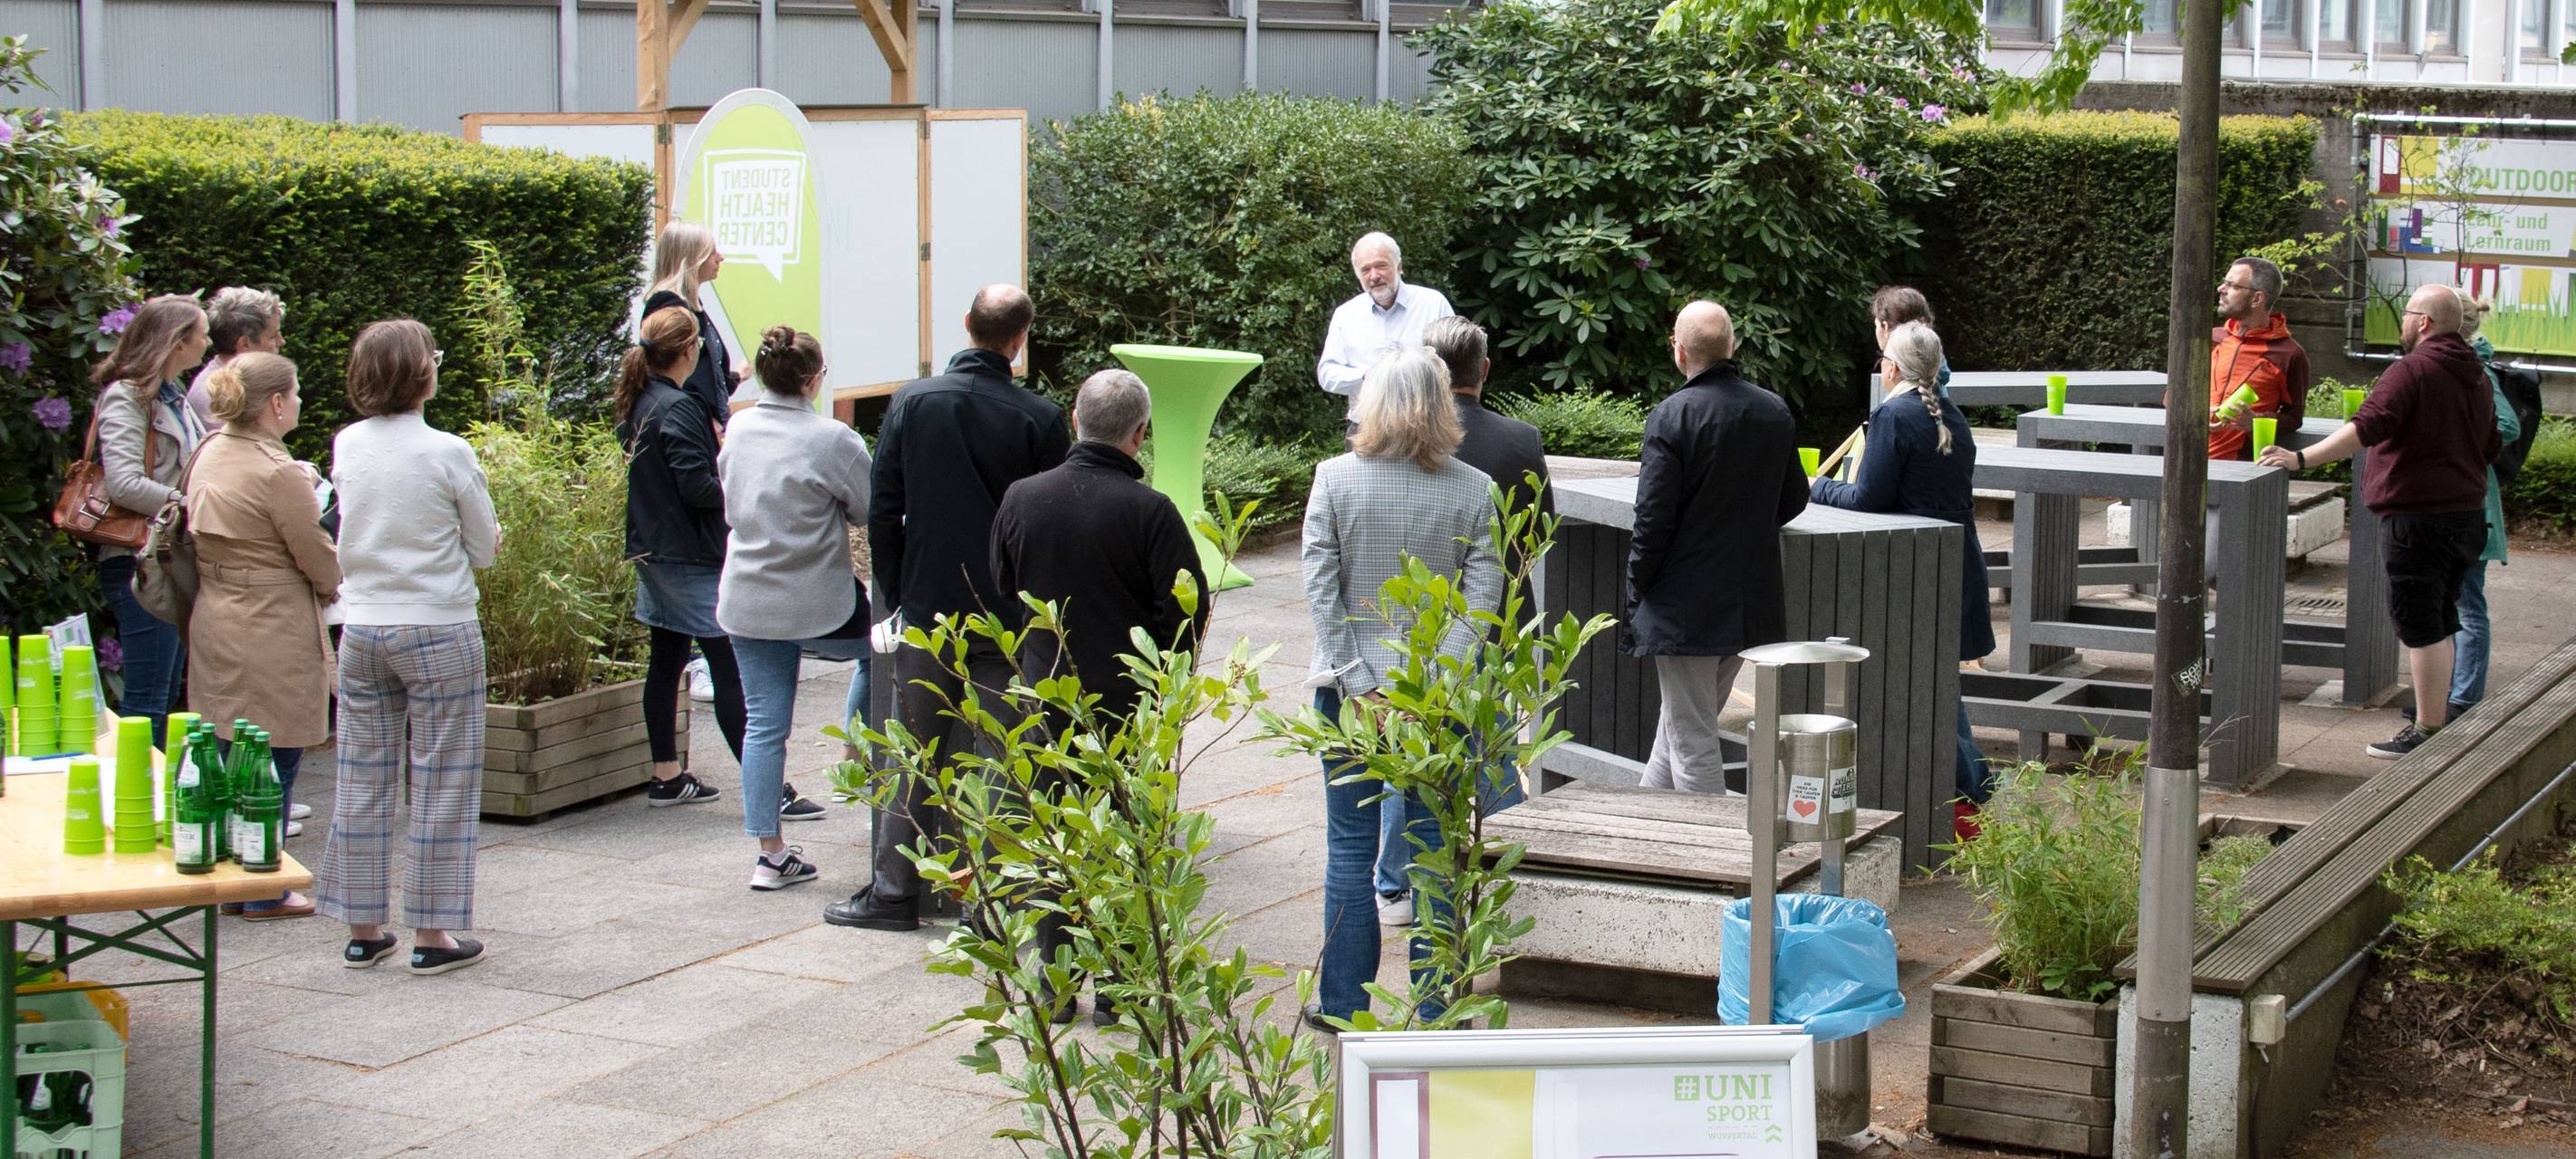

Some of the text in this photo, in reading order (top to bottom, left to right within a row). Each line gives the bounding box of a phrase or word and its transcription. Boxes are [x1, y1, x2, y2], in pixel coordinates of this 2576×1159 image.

[2516, 212, 2548, 230] und
[2465, 231, 2551, 252] Lernraum
[1706, 1105, 1773, 1122] SPORT
[1708, 1132, 1757, 1141] WUPPERTAL
